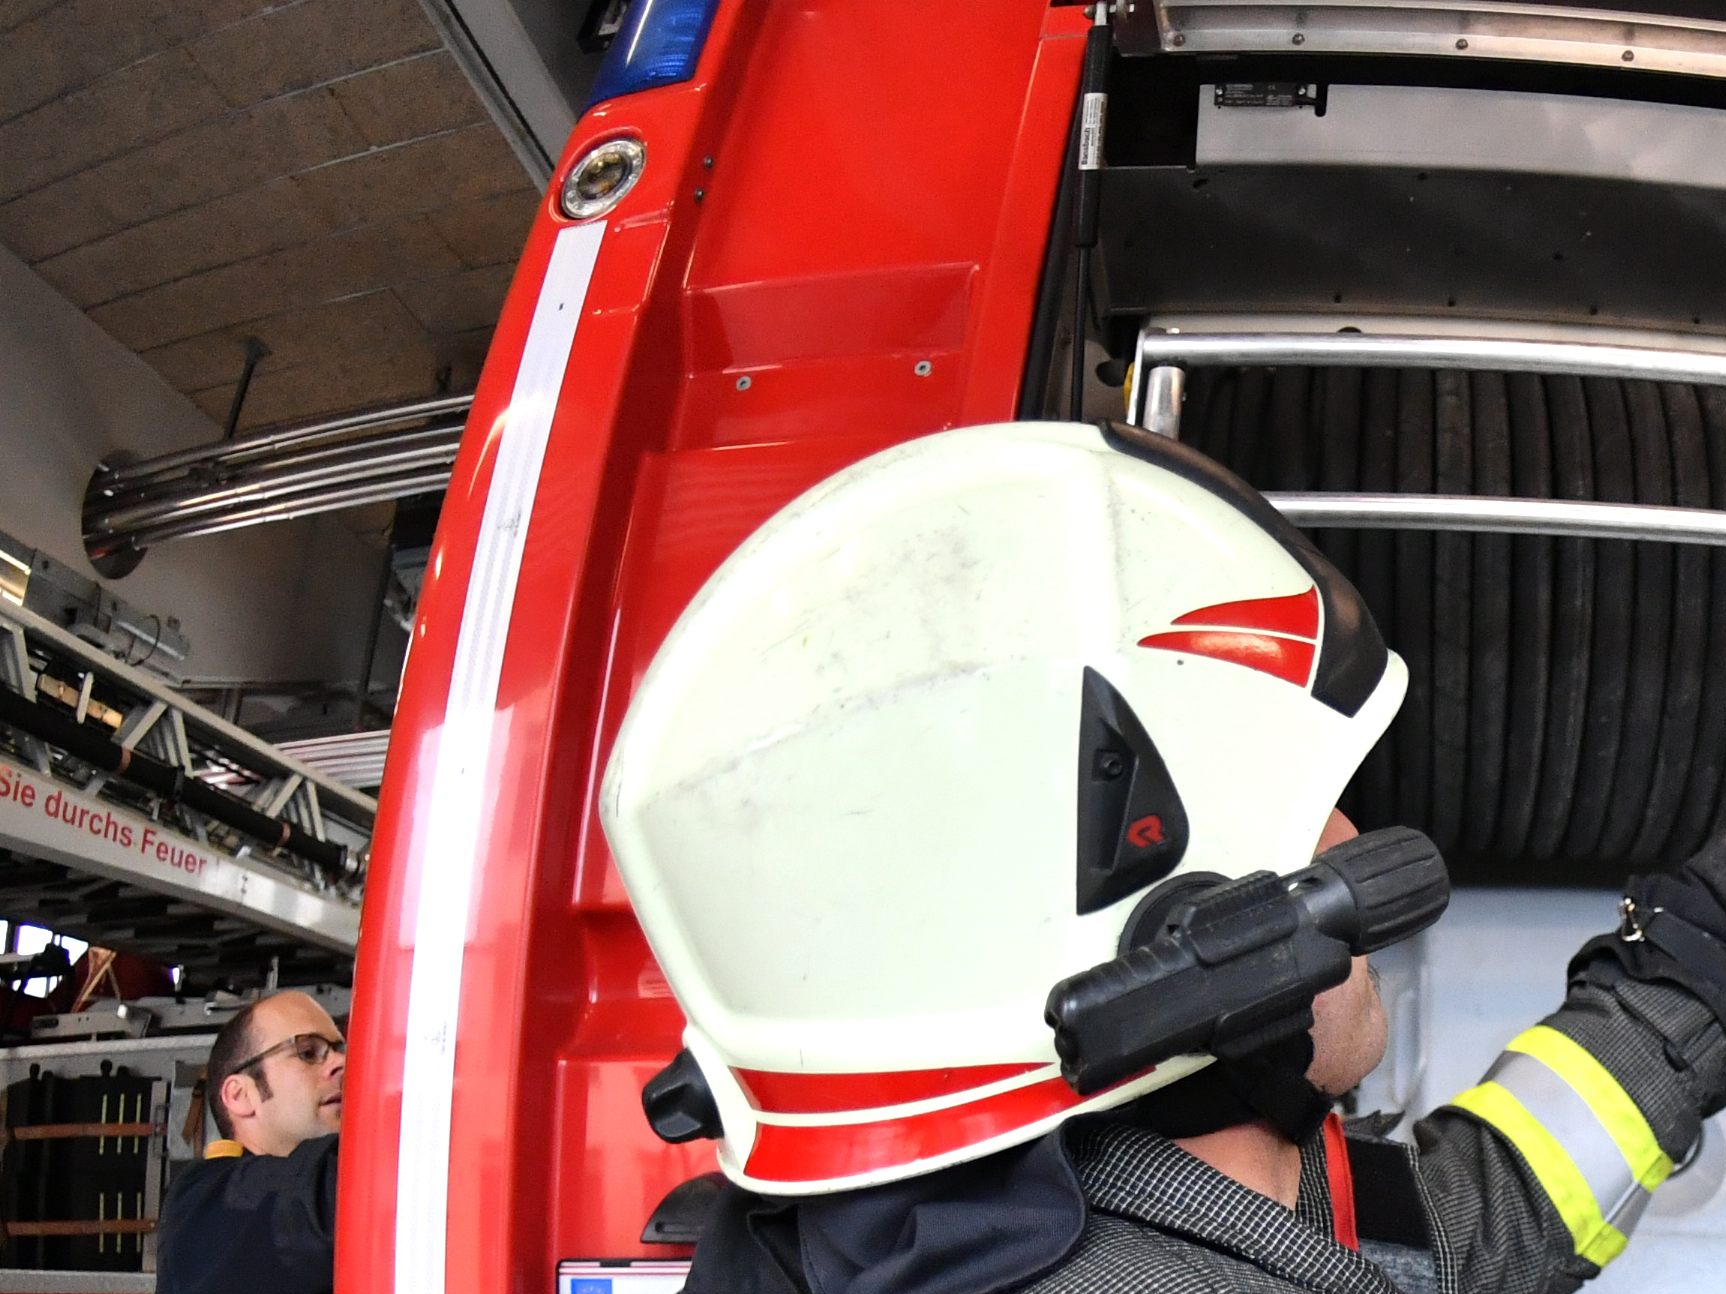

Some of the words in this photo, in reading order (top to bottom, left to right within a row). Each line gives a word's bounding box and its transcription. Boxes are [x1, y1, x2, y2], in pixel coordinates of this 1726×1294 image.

[0, 764, 36, 808] Sie
[44, 790, 133, 848] durchs
[141, 828, 208, 877] Feuer
